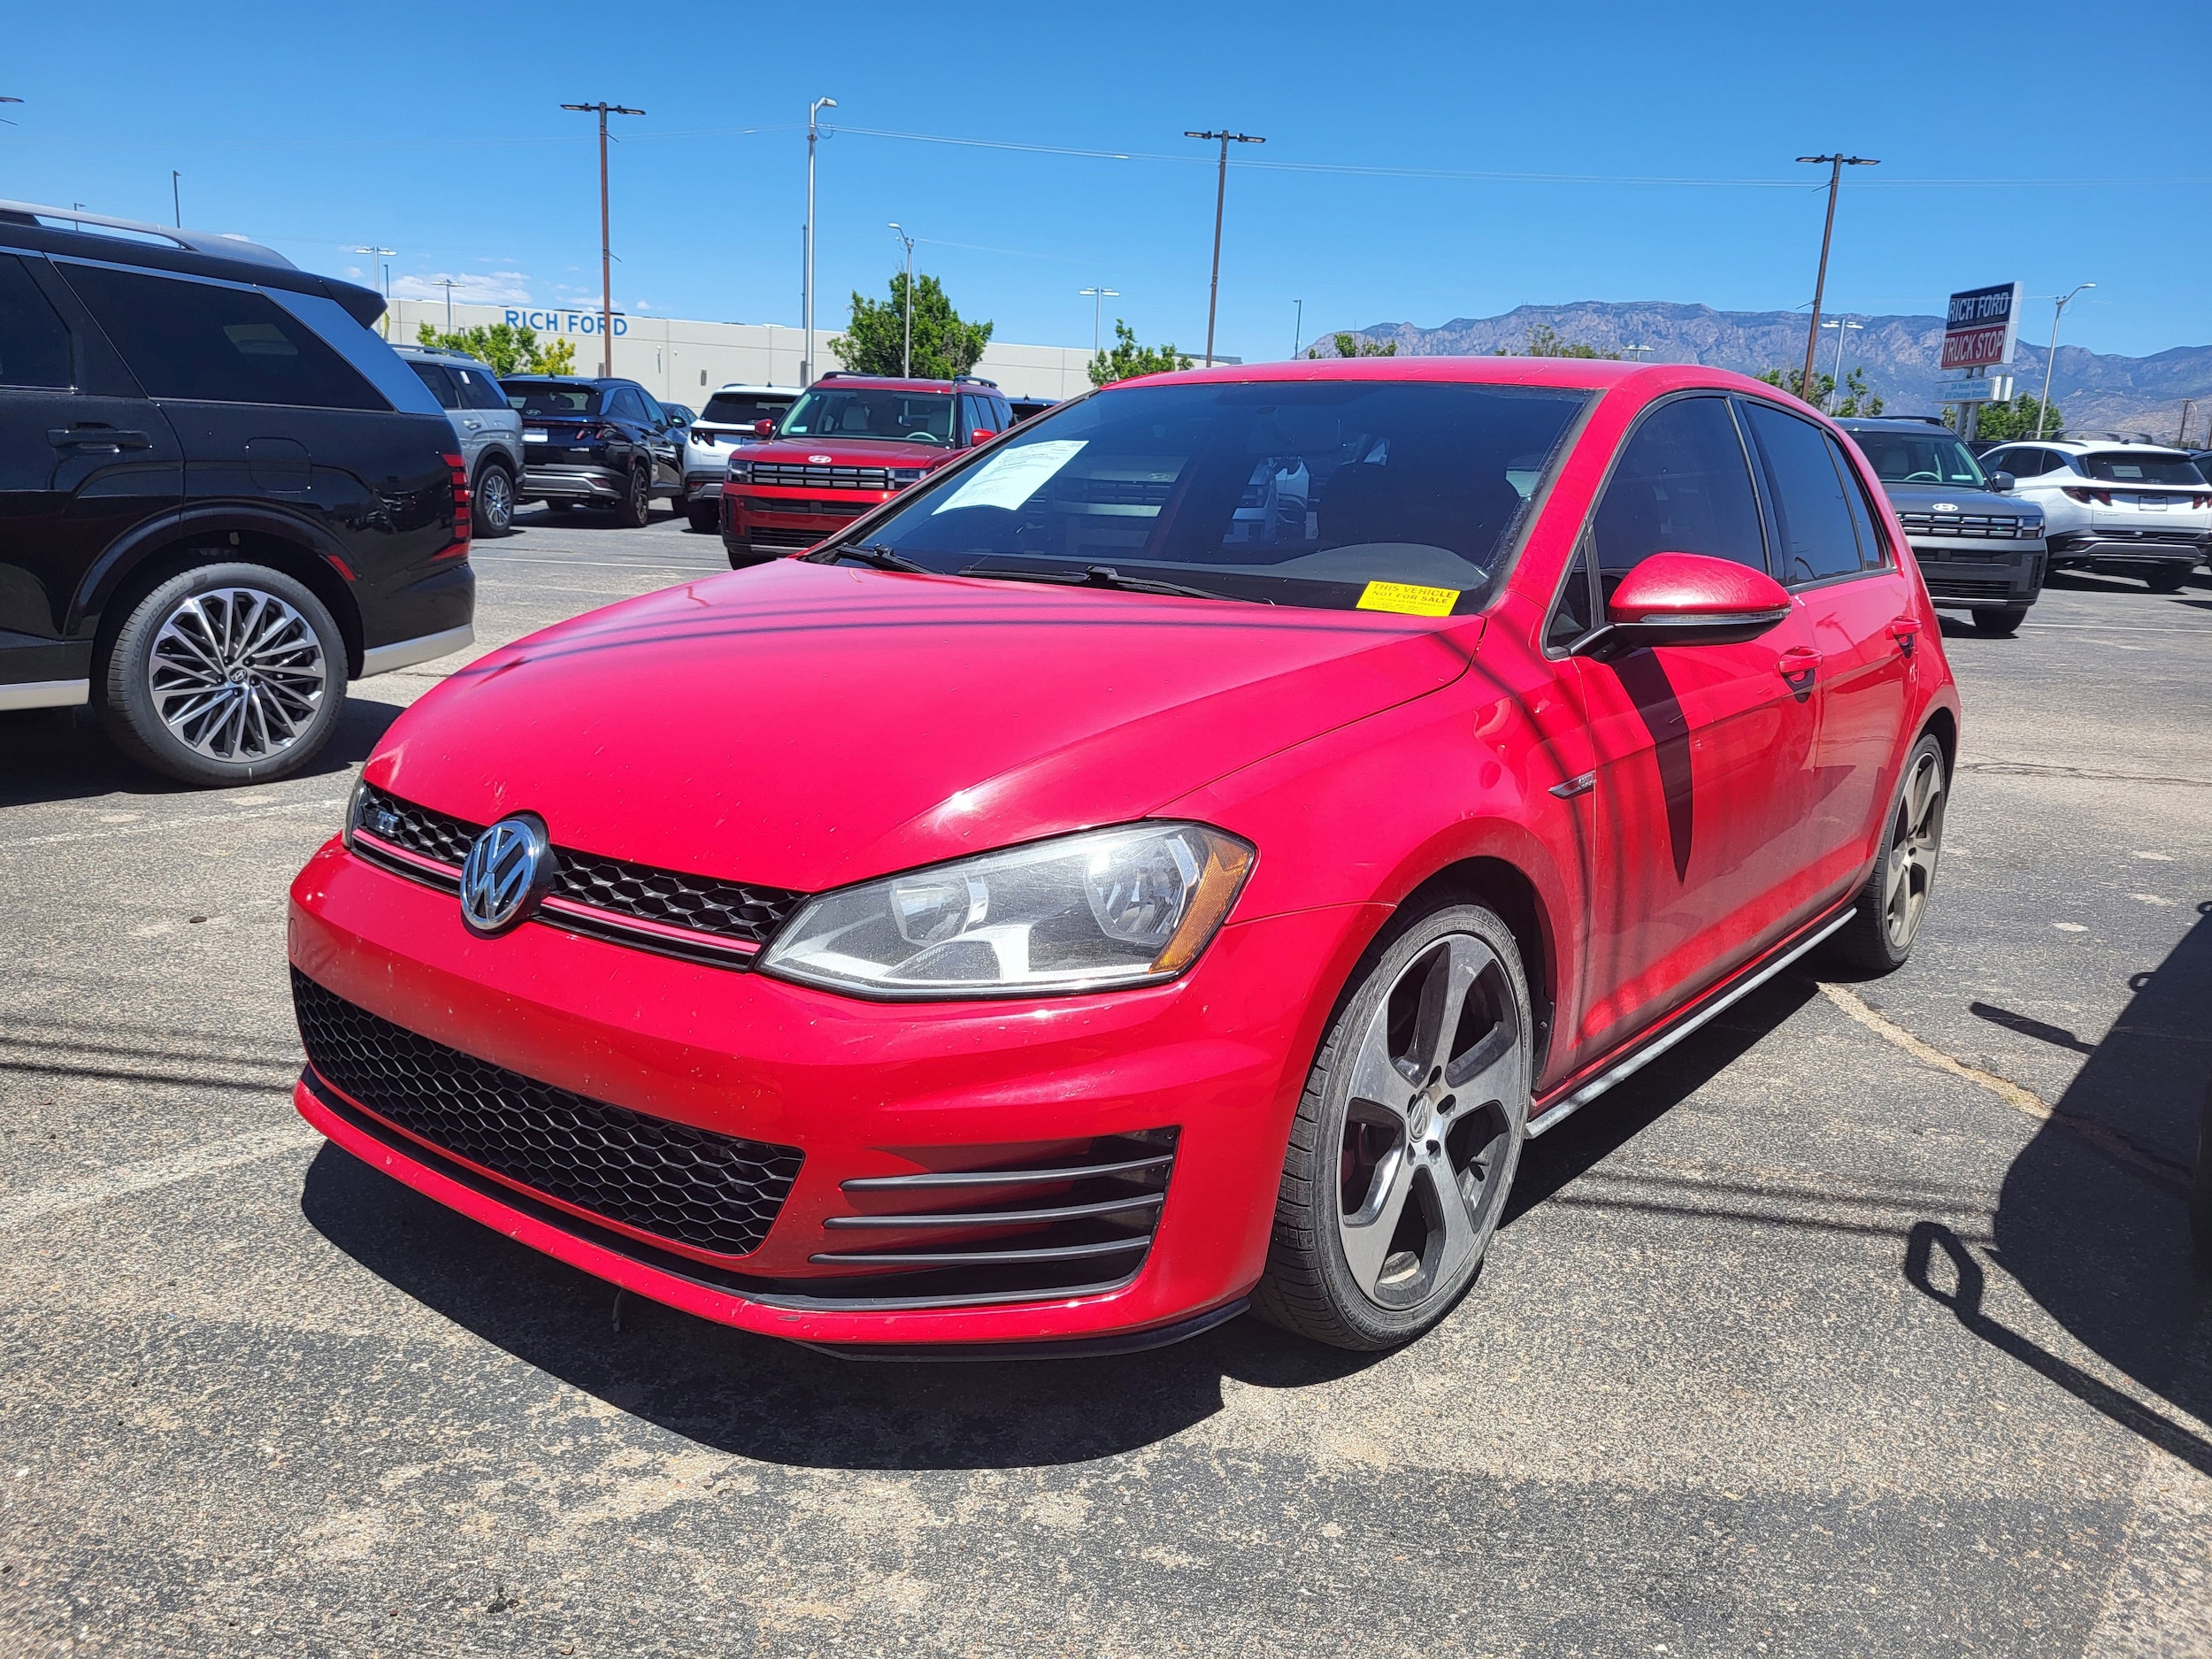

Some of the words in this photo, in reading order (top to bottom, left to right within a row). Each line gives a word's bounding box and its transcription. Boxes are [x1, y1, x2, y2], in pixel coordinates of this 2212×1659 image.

[1947, 297, 1976, 323] RICH
[1977, 291, 2009, 318] FORD
[505, 310, 558, 331] RICH
[568, 314, 628, 336] FORD
[1943, 334, 1977, 363] TRUCK
[1976, 329, 2005, 359] STOP
[1374, 583, 1399, 593] THIS
[1404, 587, 1455, 599] VEHICLE
